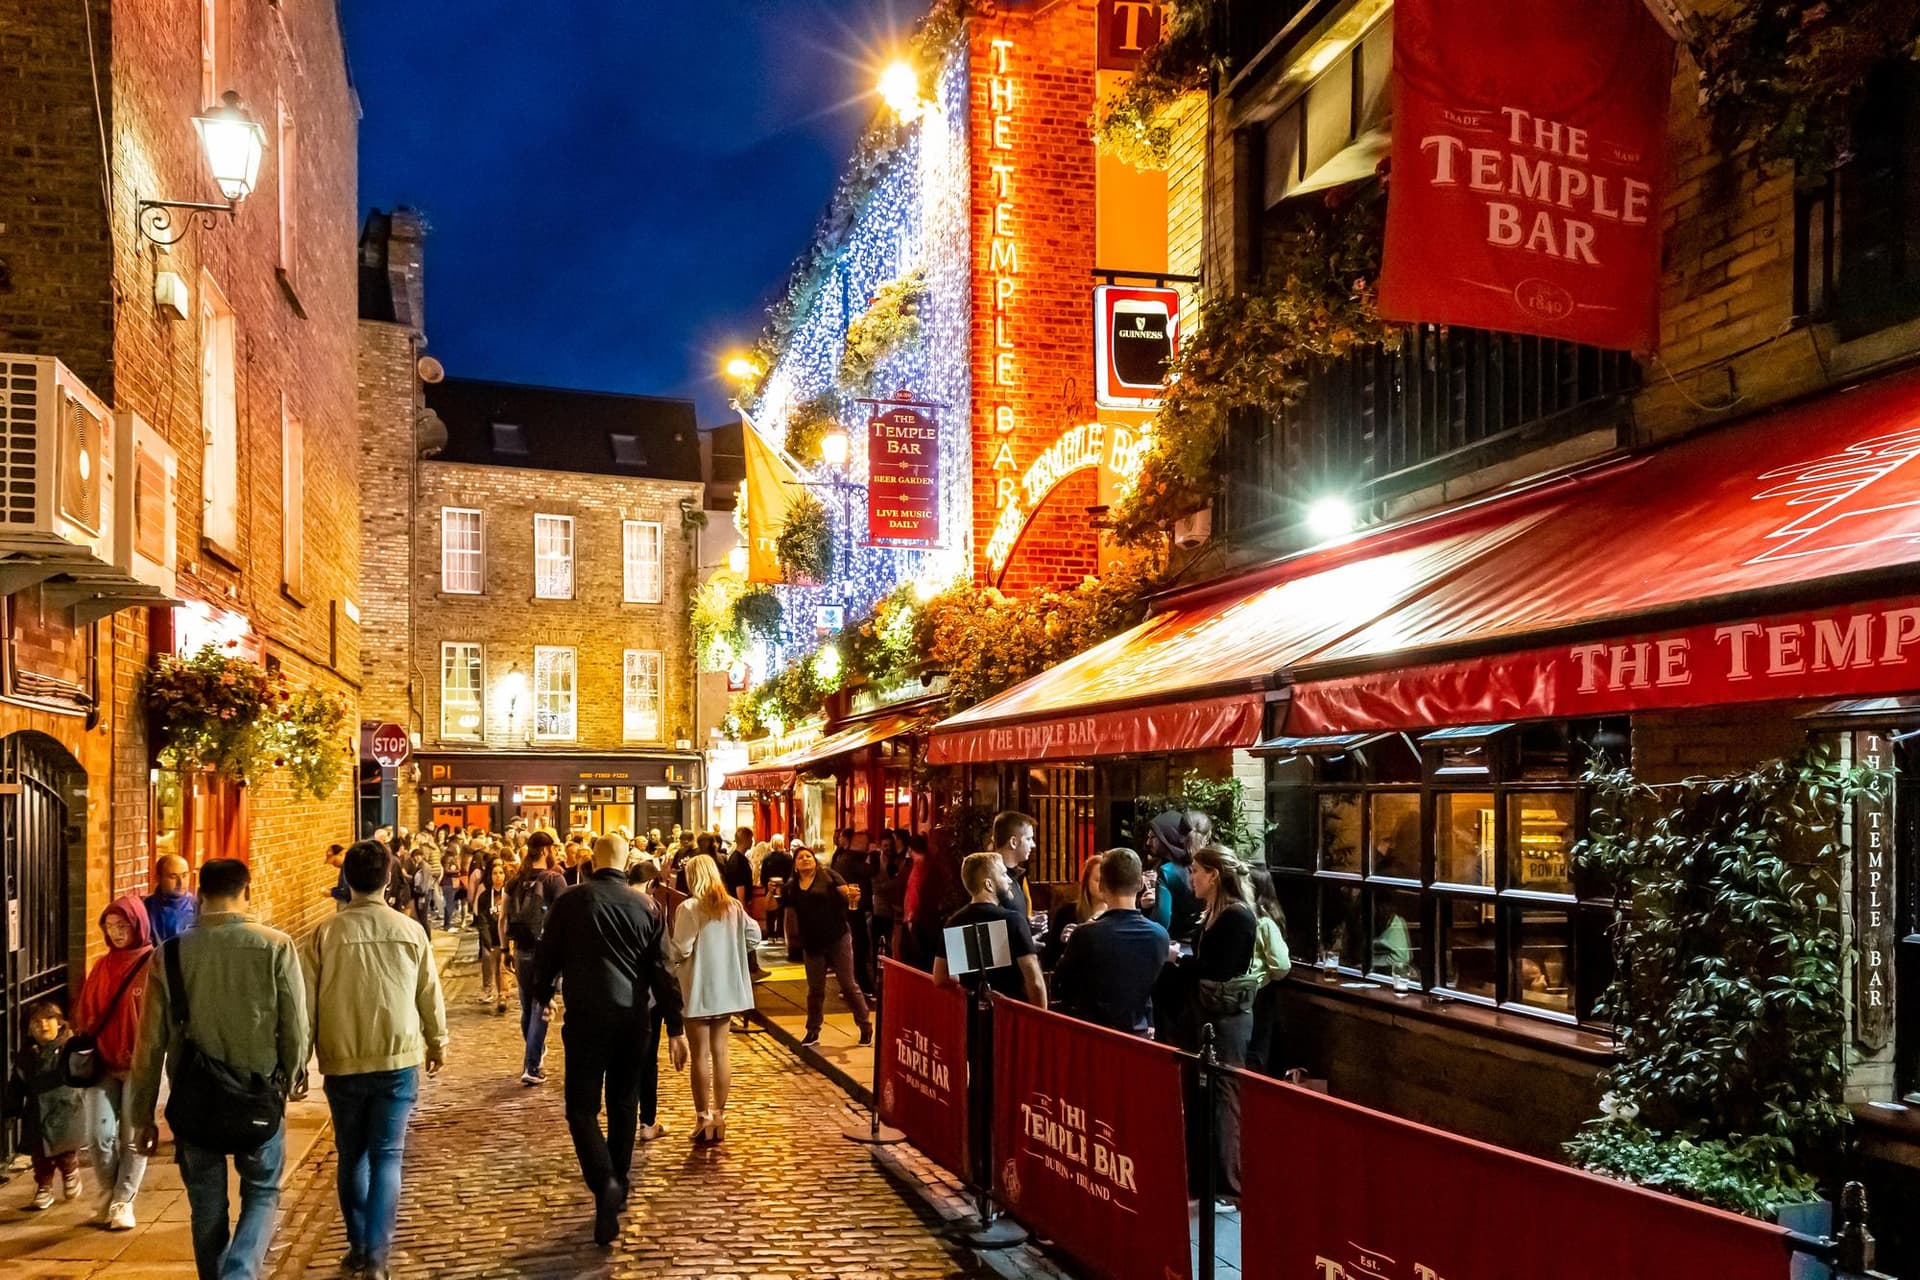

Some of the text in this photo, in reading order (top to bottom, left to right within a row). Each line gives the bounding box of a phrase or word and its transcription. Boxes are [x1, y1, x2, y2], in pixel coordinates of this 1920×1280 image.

[990, 40, 1015, 150] THE
[1501, 106, 1589, 161] THE
[1420, 135, 1651, 224] TEMPLE
[1486, 201, 1600, 265] BAR
[989, 166, 1019, 386] TEMPLE
[1119, 329, 1164, 339] GUINNESS
[872, 423, 936, 440] TEMPLE
[893, 414, 916, 424] THE
[887, 440, 922, 455] BAR
[992, 405, 1018, 509] BAR
[873, 475, 935, 485] BEER GARDEN
[876, 509, 932, 519] LIVE MUSIC
[889, 520, 919, 529] DAILY
[1569, 642, 1692, 694] THE
[374, 737, 406, 752] STOP
[988, 729, 1013, 750] THE
[1016, 723, 1065, 749] TEMPLE
[1068, 718, 1097, 745] BAR
[1868, 812, 1882, 927] TEMPLE
[1869, 951, 1882, 1006] BAR
[1093, 1143, 1138, 1194] BAR
[1360, 1255, 1381, 1271] Est.
